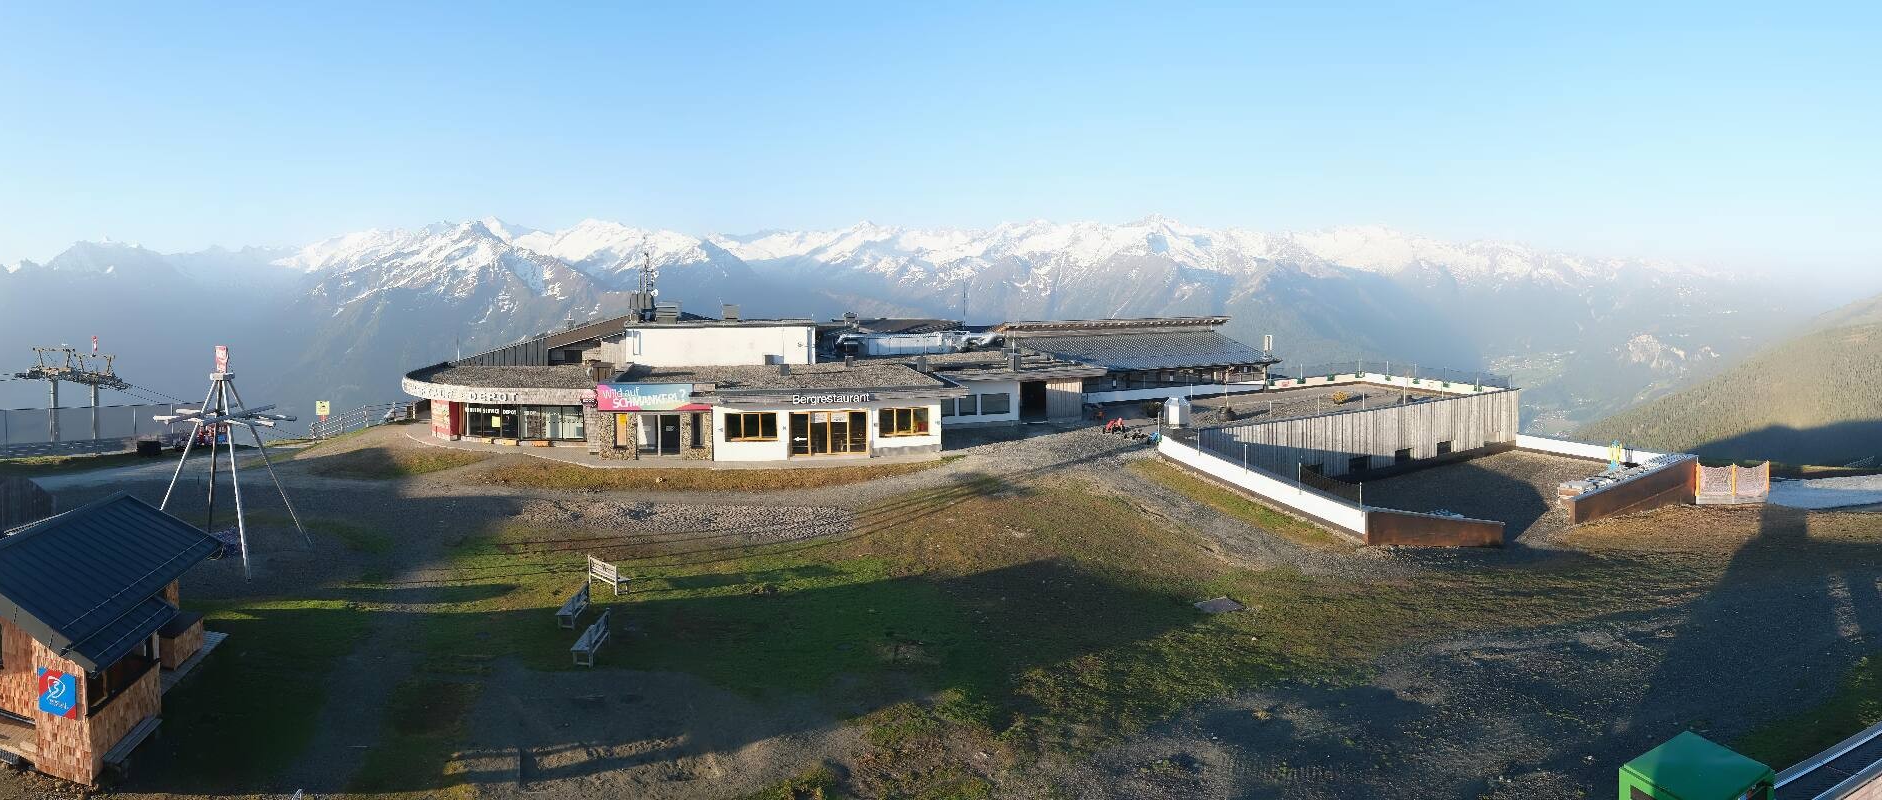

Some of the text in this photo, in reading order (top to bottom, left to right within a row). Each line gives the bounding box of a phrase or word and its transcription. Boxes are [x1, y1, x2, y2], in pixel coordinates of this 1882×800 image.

[468, 392, 519, 402] DEPOT
[602, 388, 622, 399] Wild
[624, 386, 640, 397] auf
[792, 393, 870, 406] Bergrestaurant
